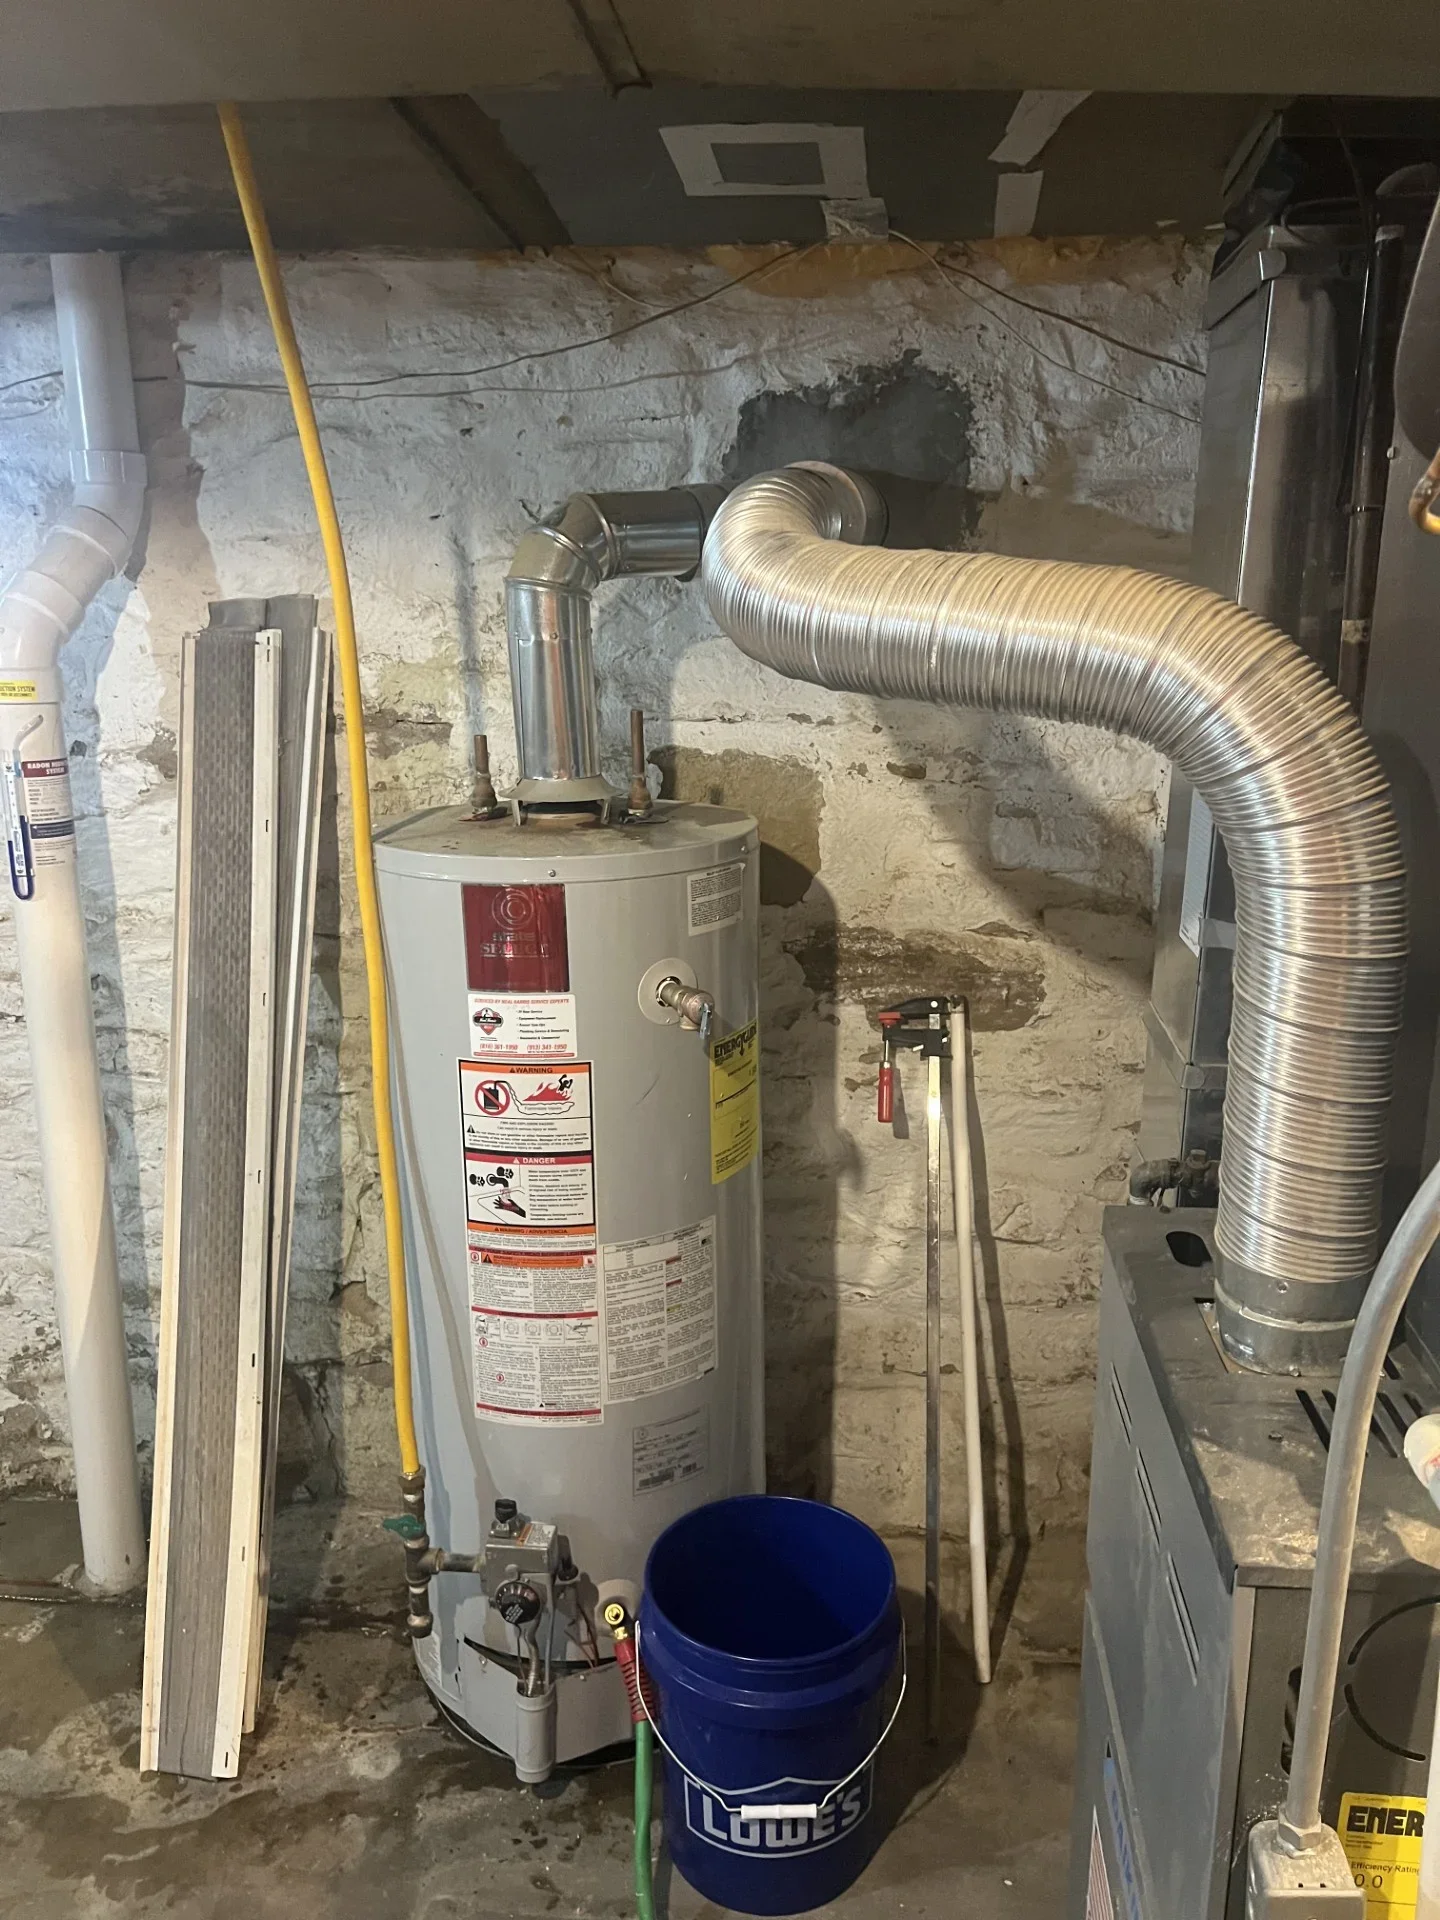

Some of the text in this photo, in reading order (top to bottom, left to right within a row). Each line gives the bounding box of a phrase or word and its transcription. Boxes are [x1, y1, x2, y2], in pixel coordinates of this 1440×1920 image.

[522, 1157, 556, 1165] DANGER
[1346, 1805, 1425, 1838] ENER
[1351, 1861, 1394, 1874] Efficiency
[1354, 1873, 1383, 1889] 0.0
